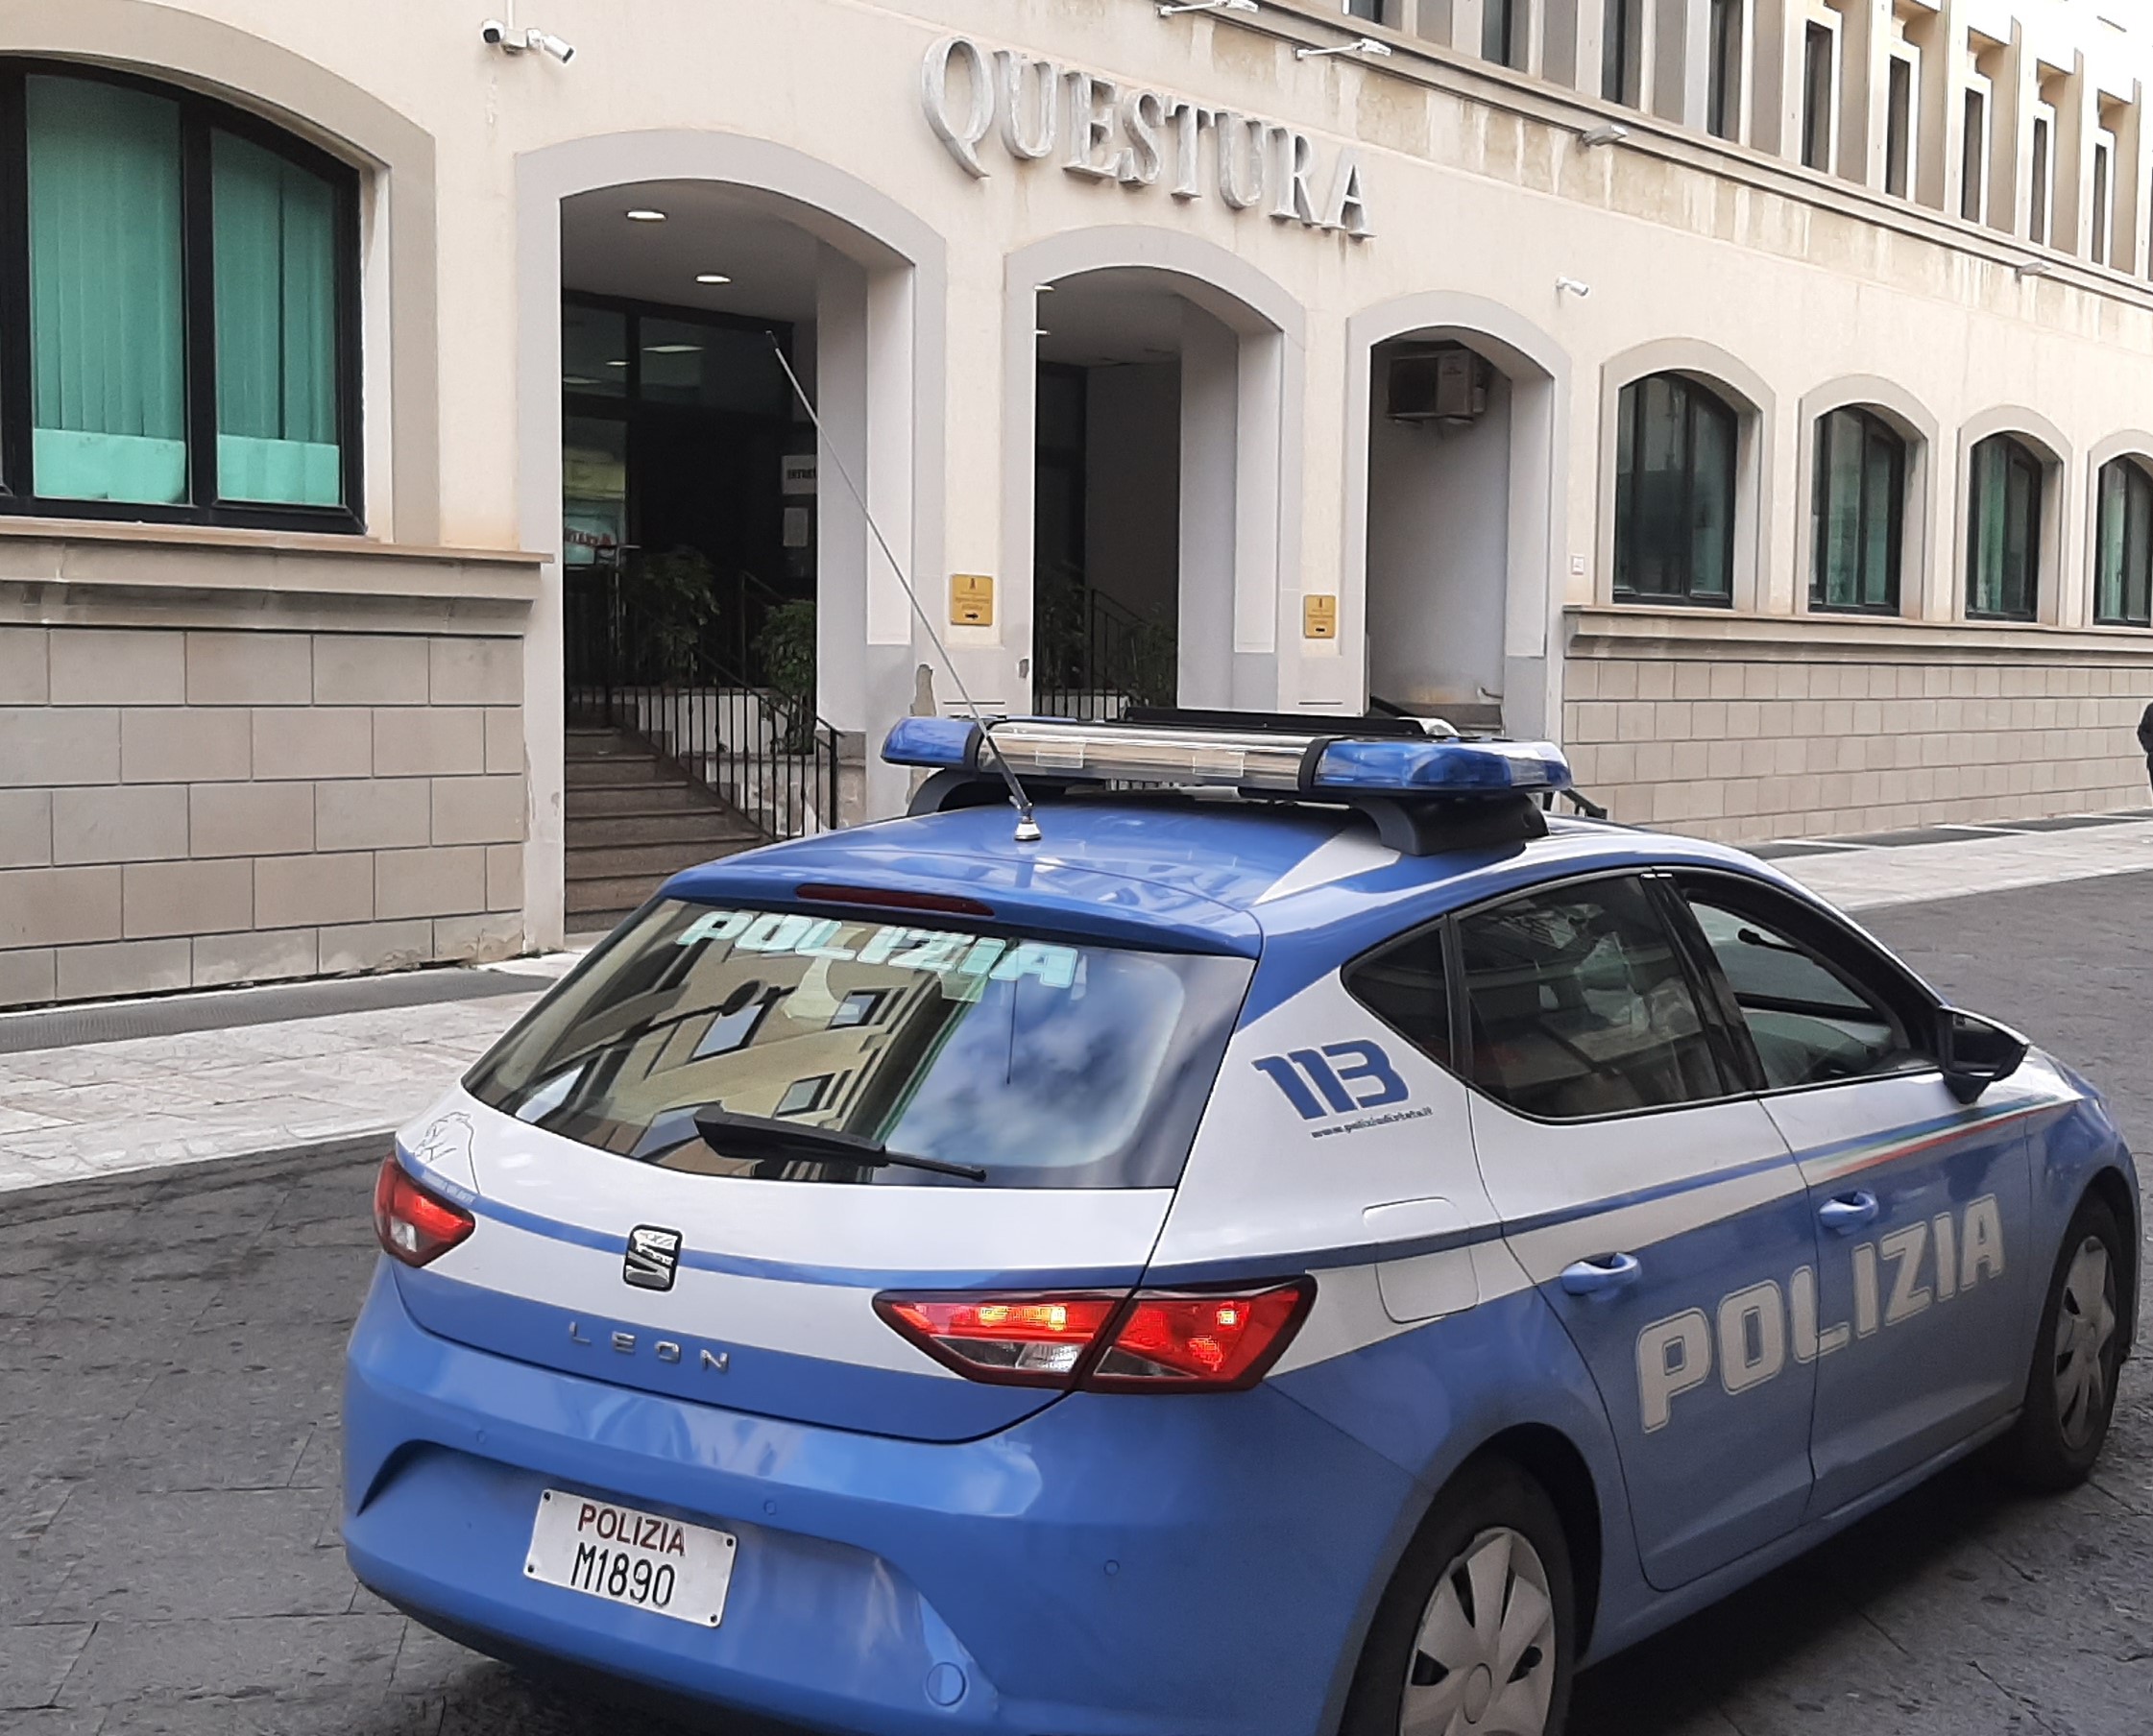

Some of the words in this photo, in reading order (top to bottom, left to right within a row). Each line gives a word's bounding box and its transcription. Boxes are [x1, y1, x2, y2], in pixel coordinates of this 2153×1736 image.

[921, 36, 1377, 243] QUESTURA
[675, 911, 1078, 989] POLIZIA
[1251, 1039, 1410, 1120] 113
[569, 1321, 730, 1373] LEON
[1636, 1194, 2005, 1435] POLIZIA
[577, 1504, 686, 1556] POLIZIA
[570, 1542, 675, 1607] M1890
